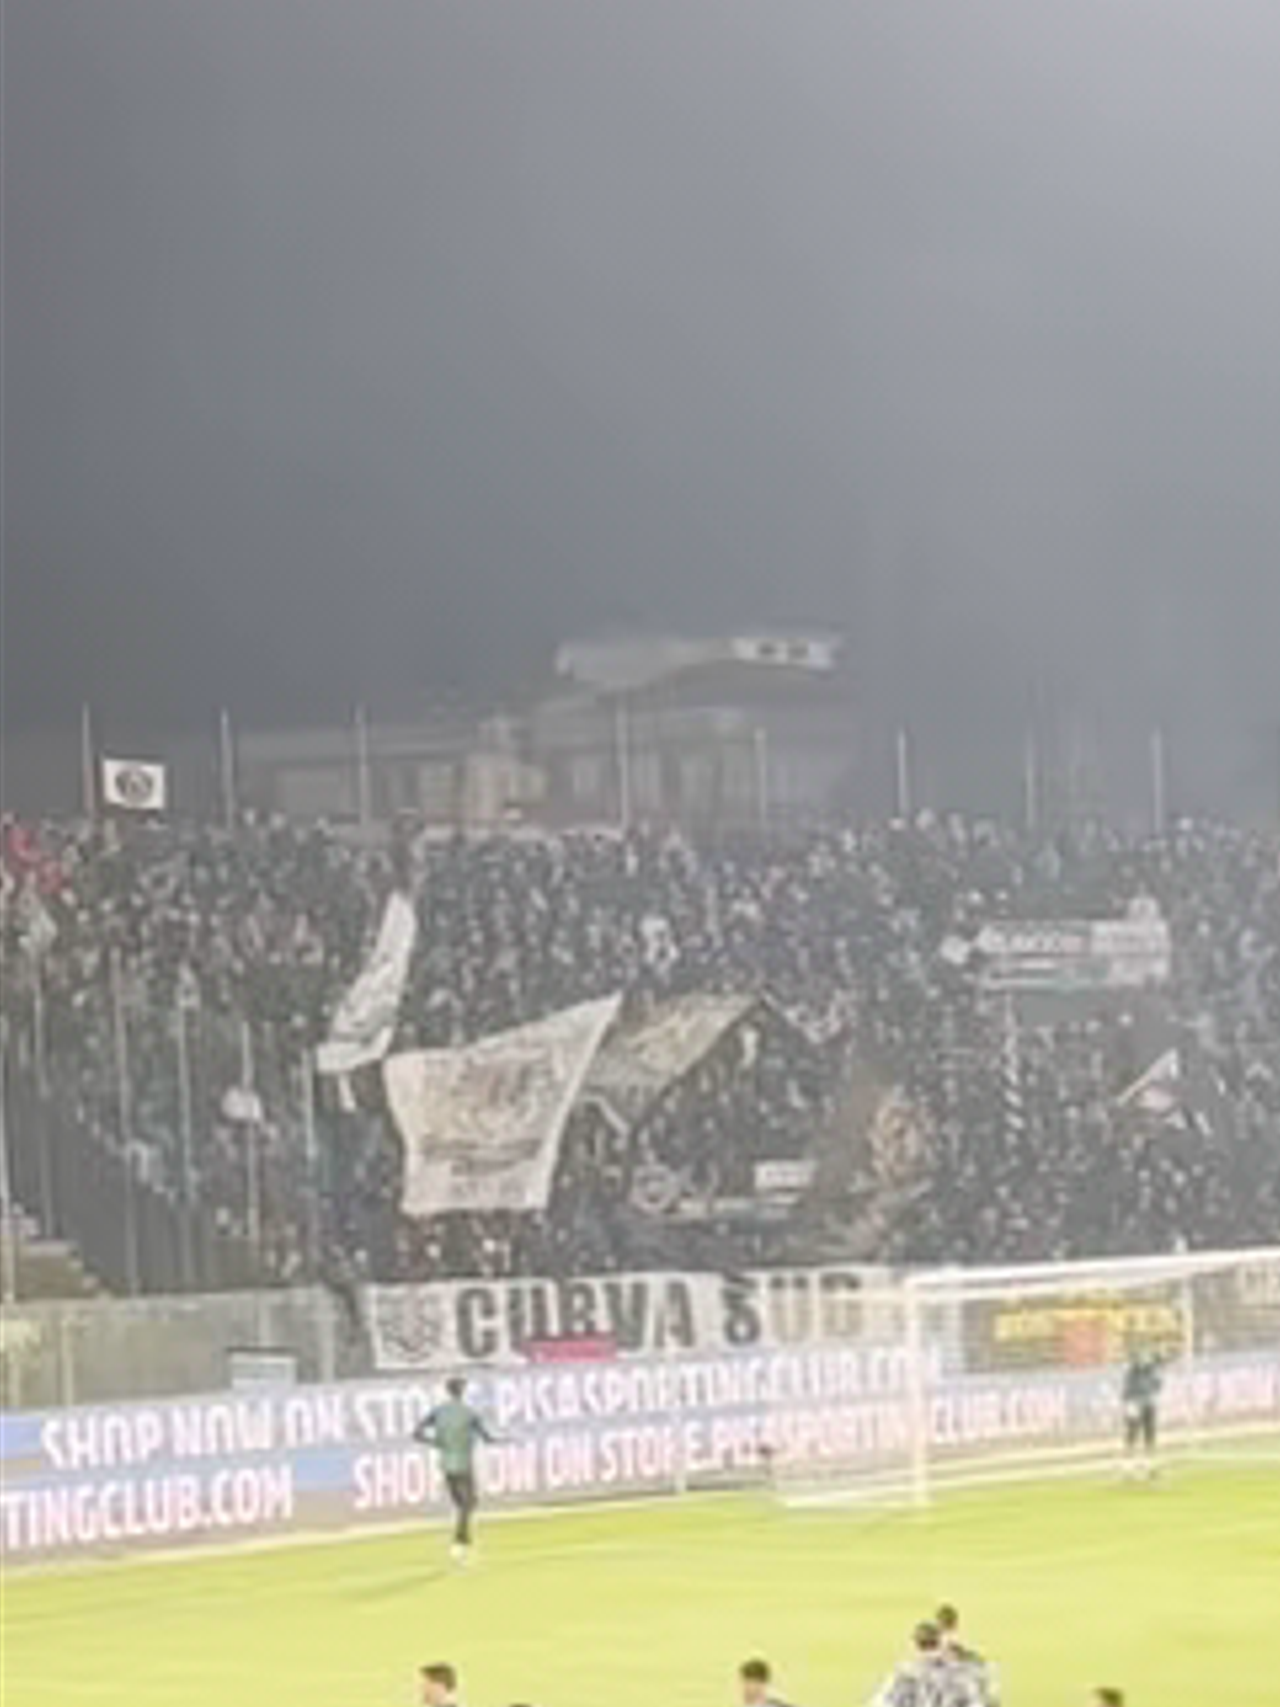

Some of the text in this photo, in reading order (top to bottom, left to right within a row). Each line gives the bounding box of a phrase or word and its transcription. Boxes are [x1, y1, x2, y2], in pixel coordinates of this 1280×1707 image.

[455, 1270, 867, 1359] CURVA SUD
[41, 1414, 164, 1470] SHOP
[172, 1404, 274, 1456] NOW
[286, 1396, 346, 1447] ON
[1, 1464, 294, 1551] TINGCLUB.COM
